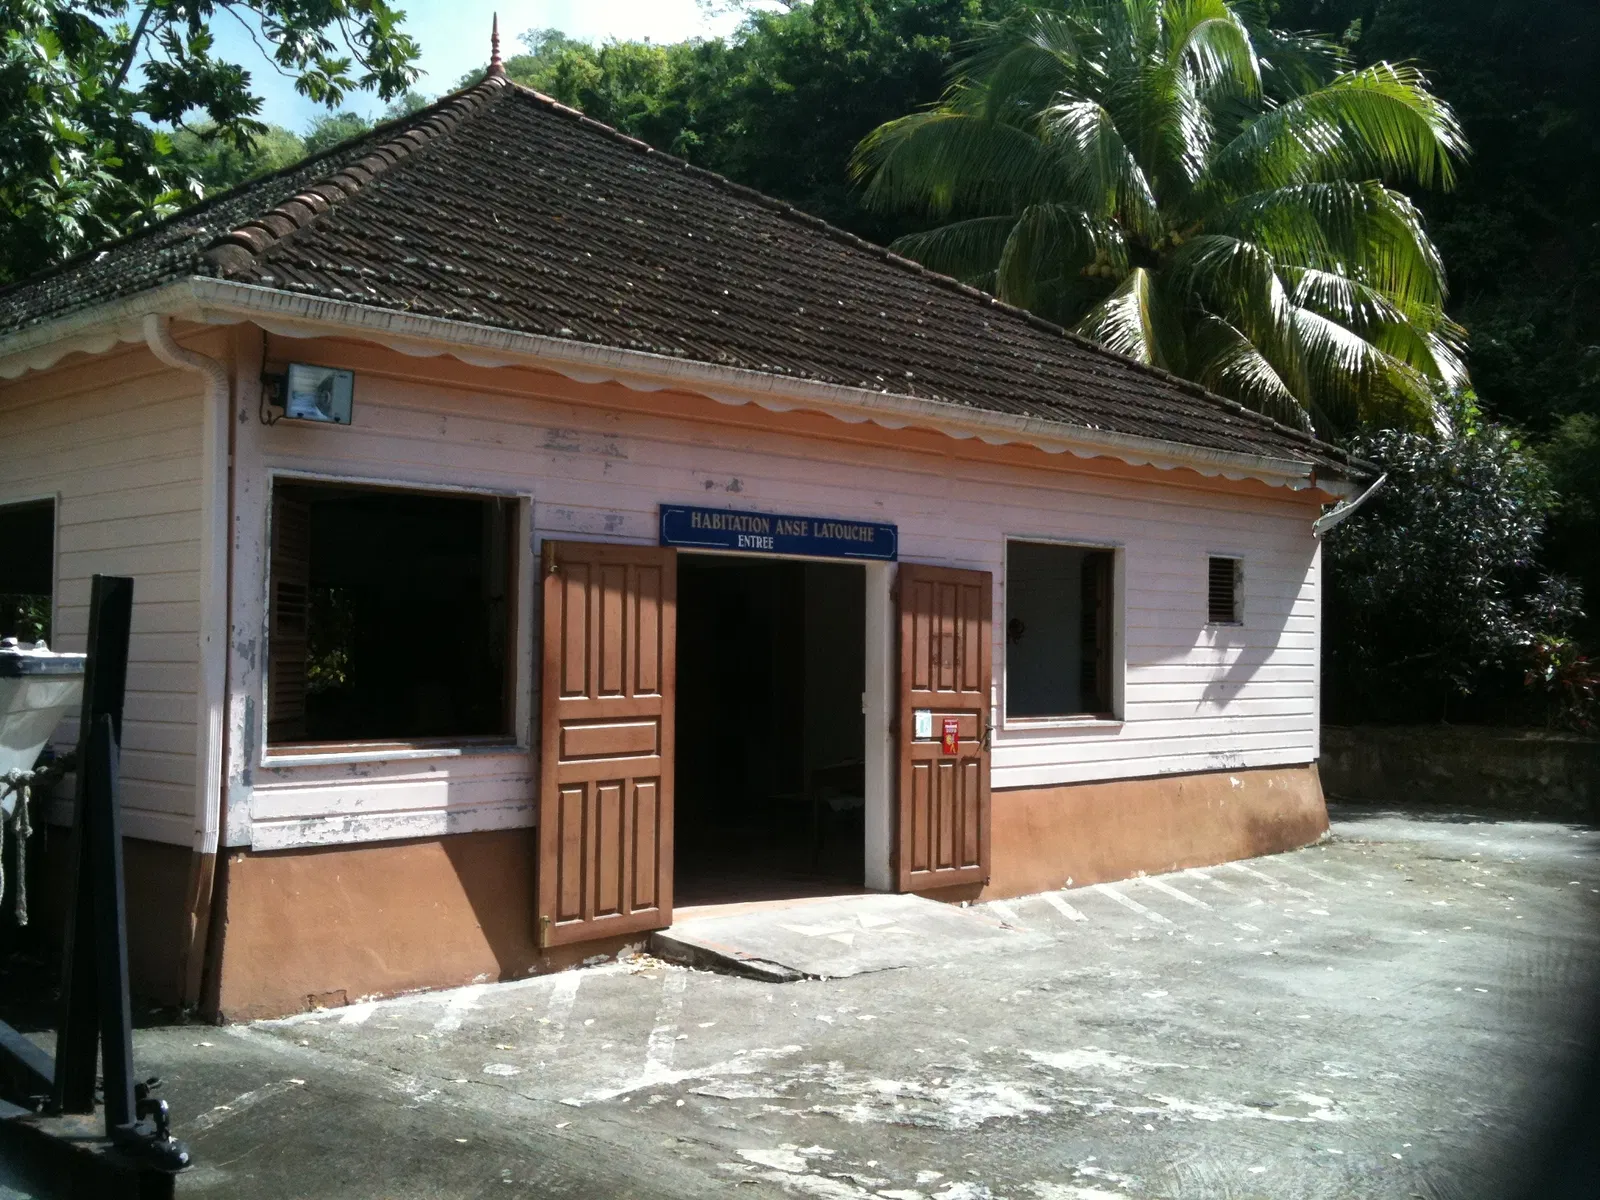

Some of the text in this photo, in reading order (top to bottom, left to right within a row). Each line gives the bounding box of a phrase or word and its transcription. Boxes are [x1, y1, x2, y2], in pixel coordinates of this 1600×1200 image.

[691, 511, 874, 542] HABITATION ANSE LATOUCHE
[738, 535, 774, 549] ENTREE
